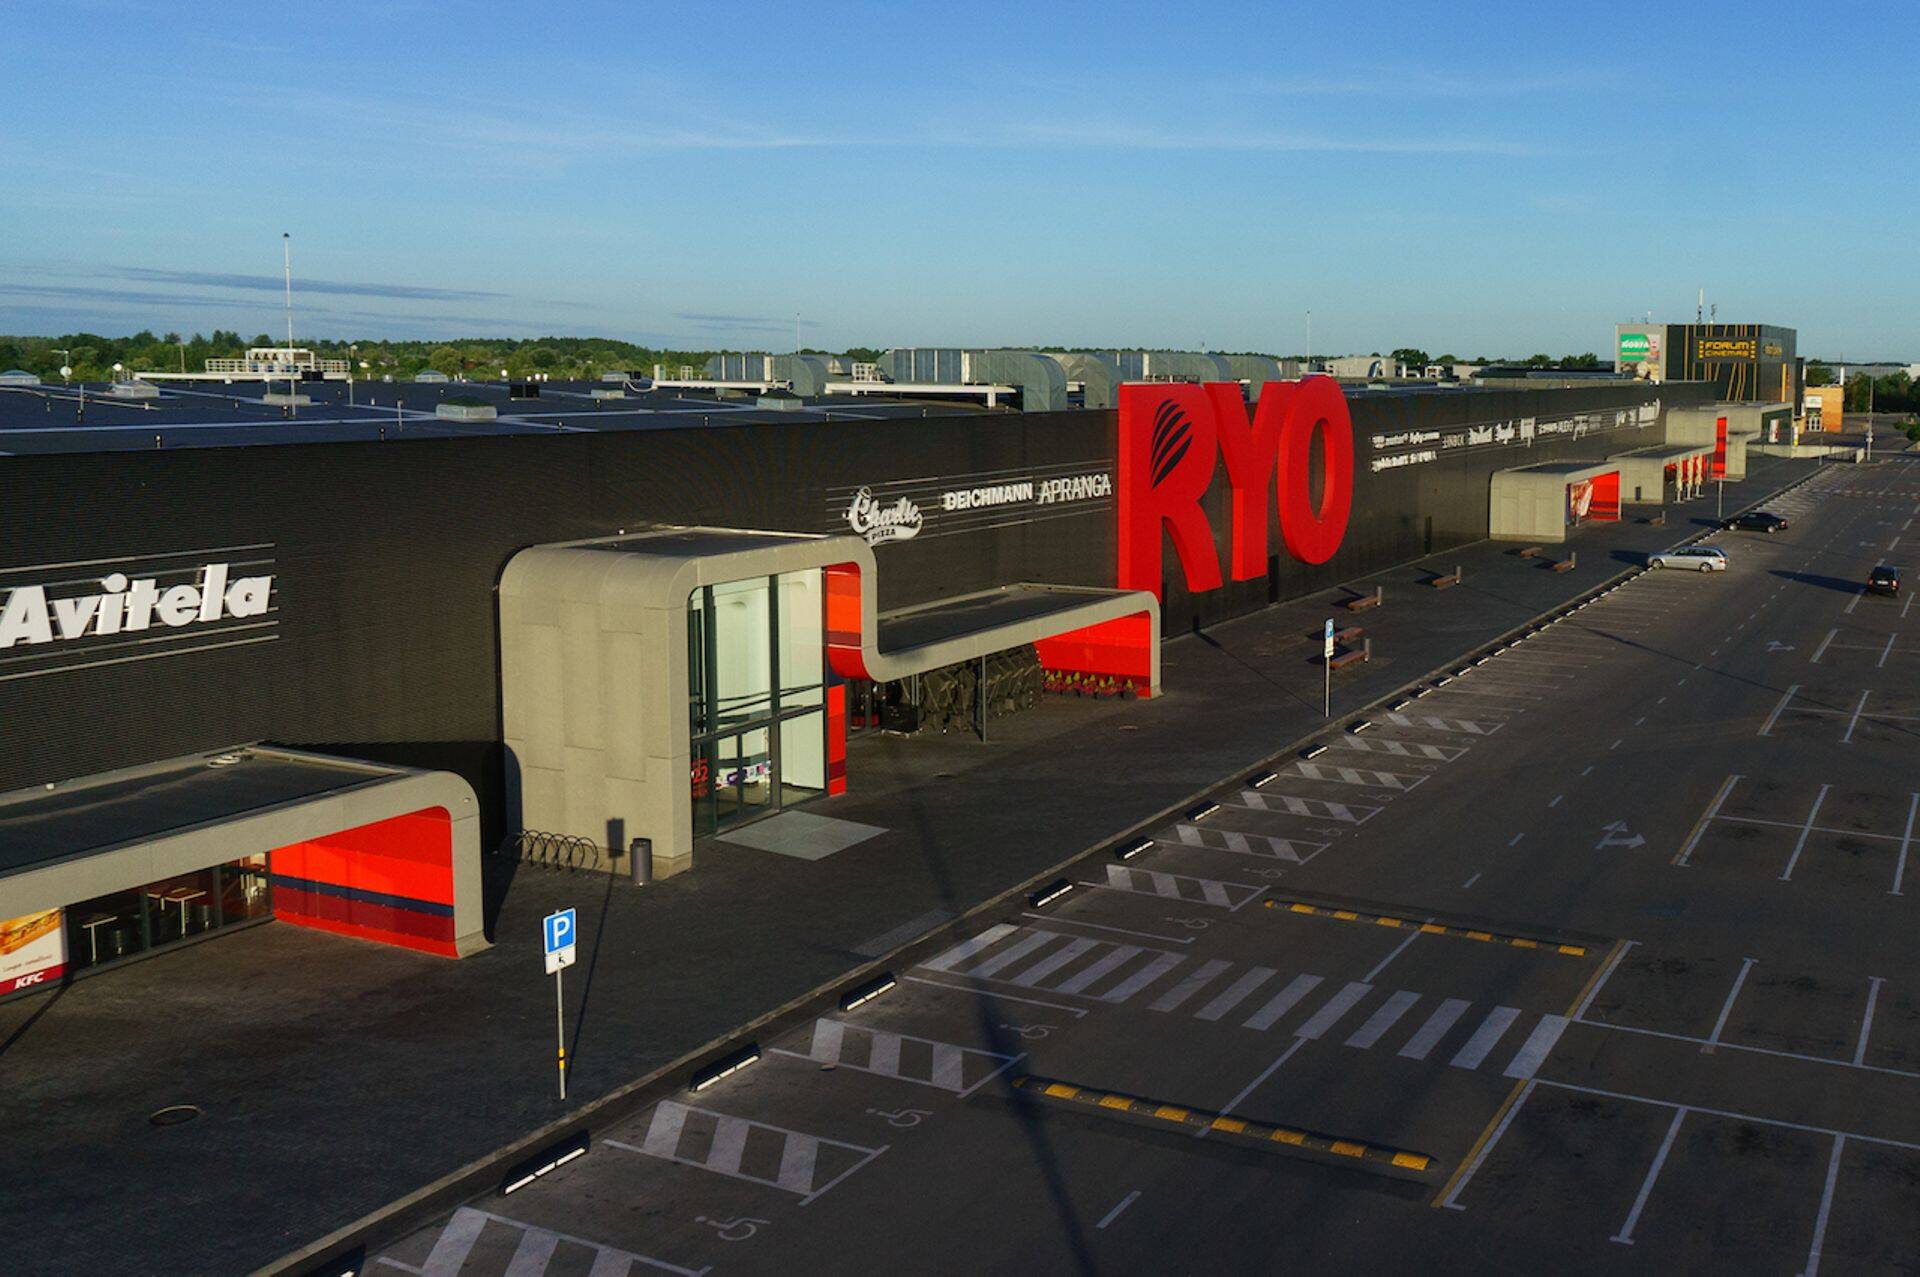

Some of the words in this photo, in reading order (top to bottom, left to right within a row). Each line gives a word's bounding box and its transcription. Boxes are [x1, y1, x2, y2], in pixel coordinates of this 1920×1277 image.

[1704, 341, 1750, 350] FORUM
[944, 483, 1033, 511] DEICHMANN
[1036, 474, 1111, 505] APRANGA
[1118, 374, 1354, 604] RYO
[0, 563, 272, 648] Avitela
[553, 917, 570, 948] P
[14, 971, 45, 989] KFC
